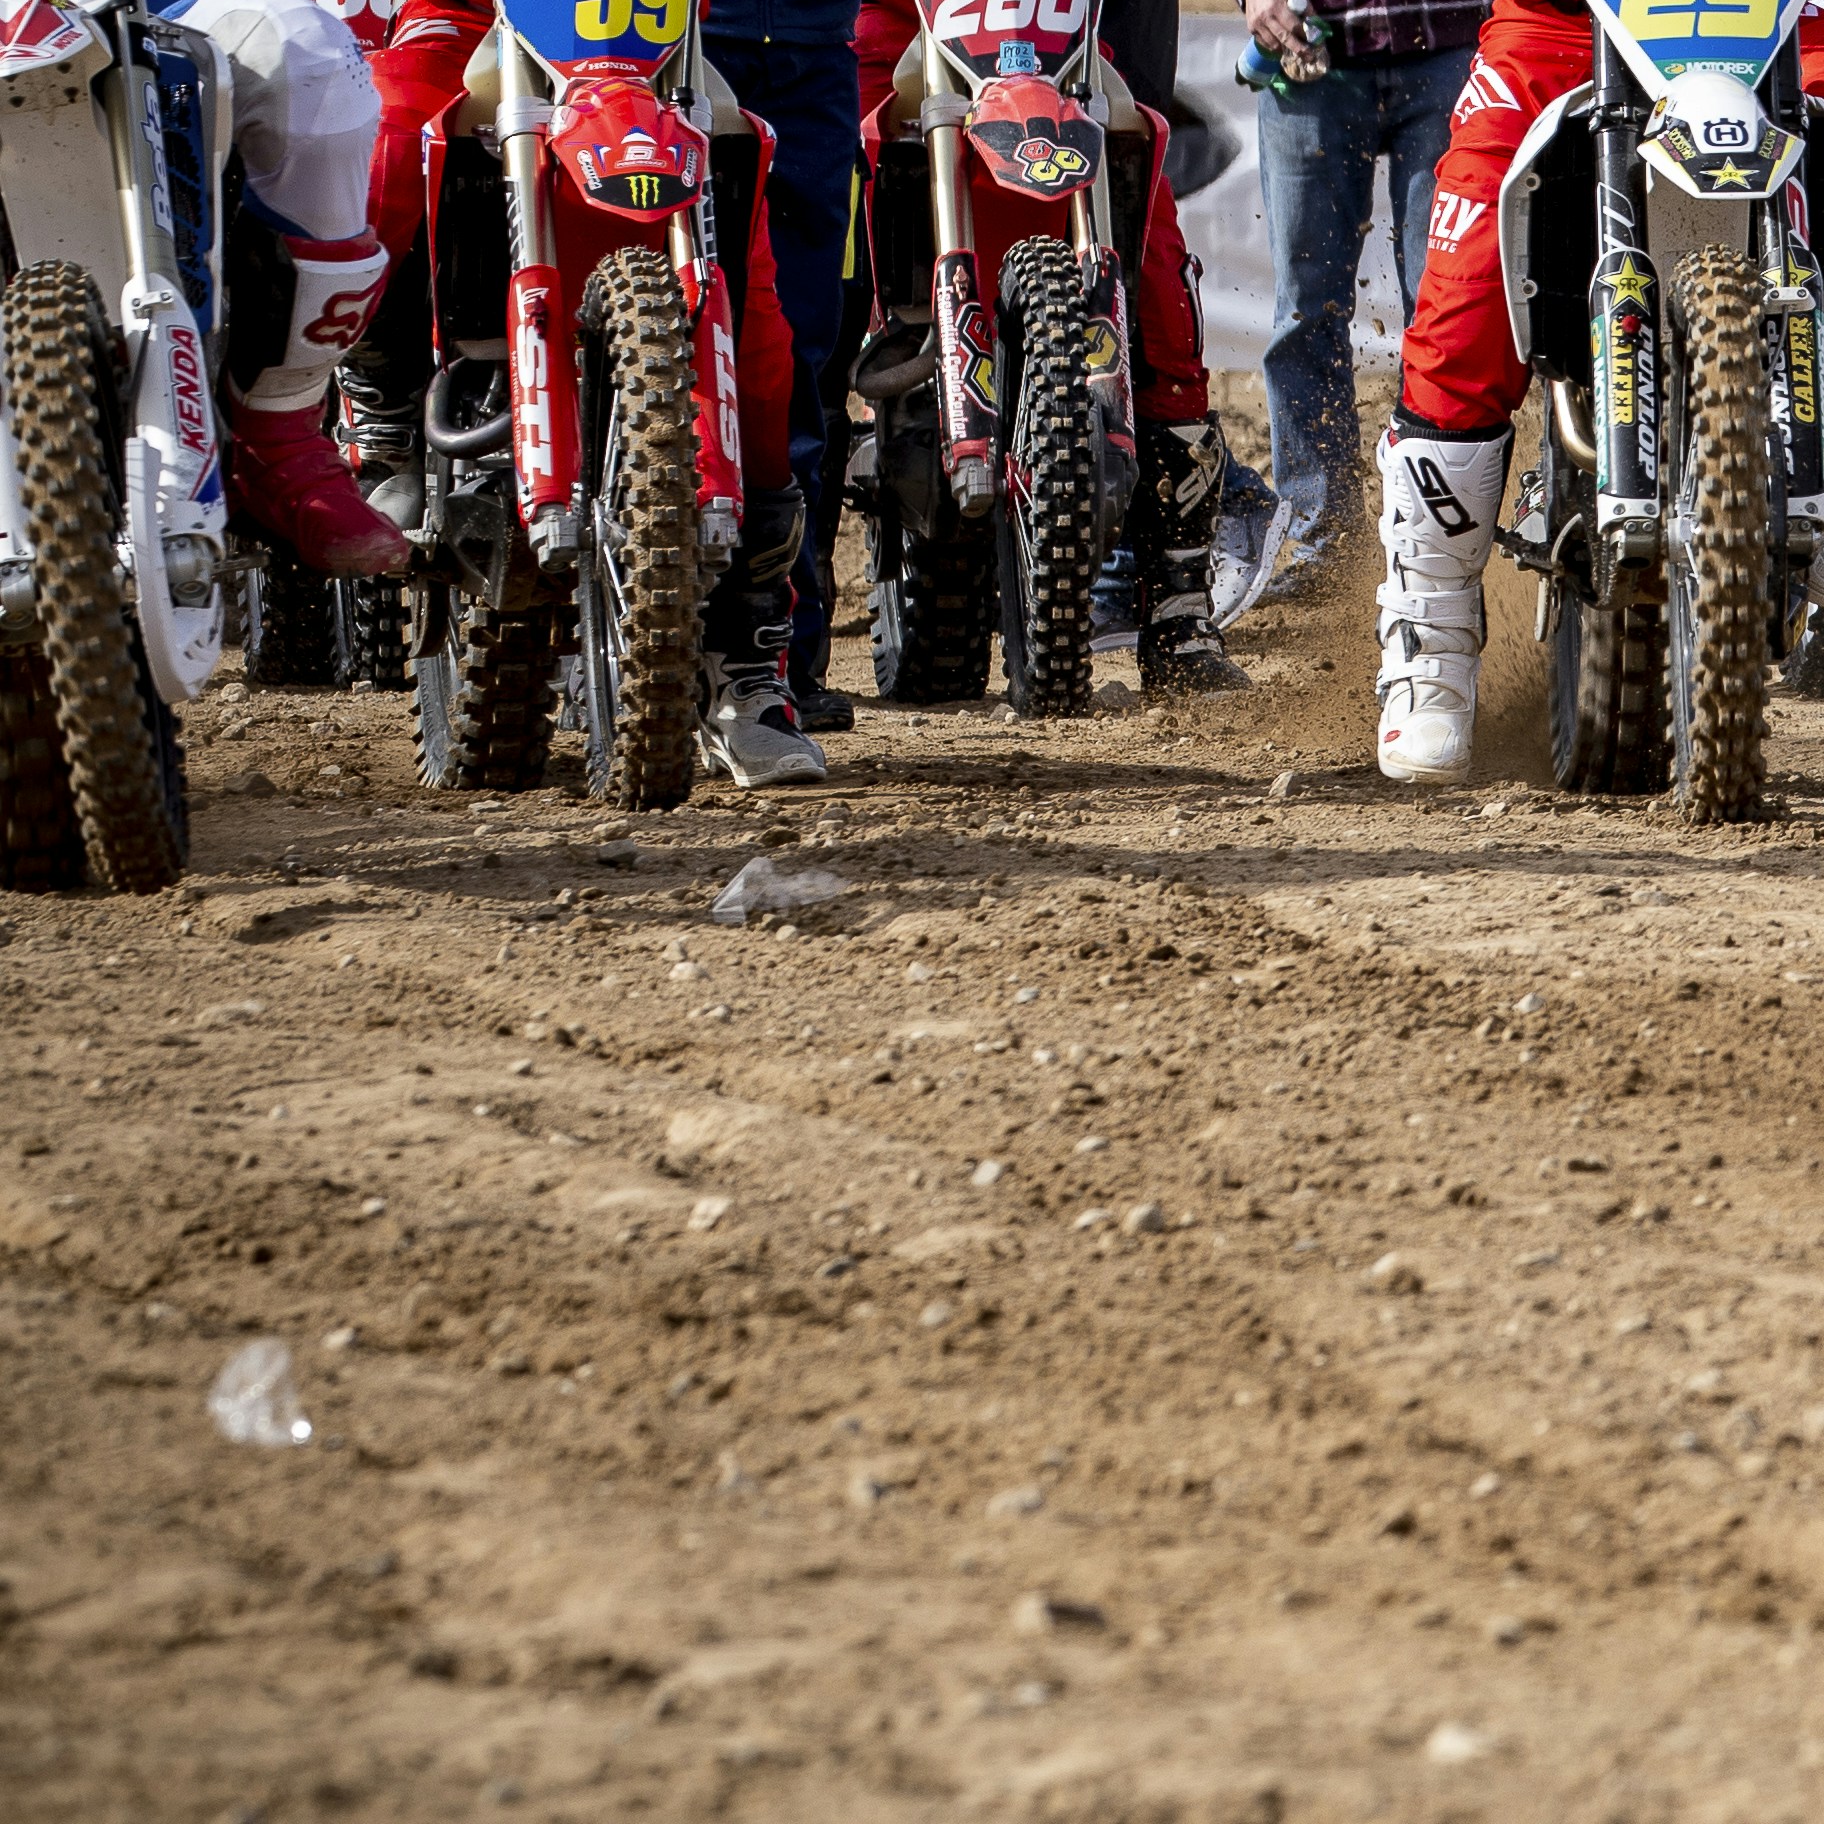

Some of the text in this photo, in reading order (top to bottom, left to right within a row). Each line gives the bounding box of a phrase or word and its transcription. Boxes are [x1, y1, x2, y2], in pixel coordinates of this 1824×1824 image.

[588, 60, 639, 72] HONDA
[1685, 61, 1758, 77] MOTOREX
[141, 81, 176, 236] Beta
[1429, 191, 1488, 244] FLY
[171, 327, 207, 453] KENDA
[516, 323, 553, 475] STI
[713, 323, 743, 470] STI
[1635, 321, 1658, 481] DUNLOP
[1788, 315, 1816, 424] GALFER
